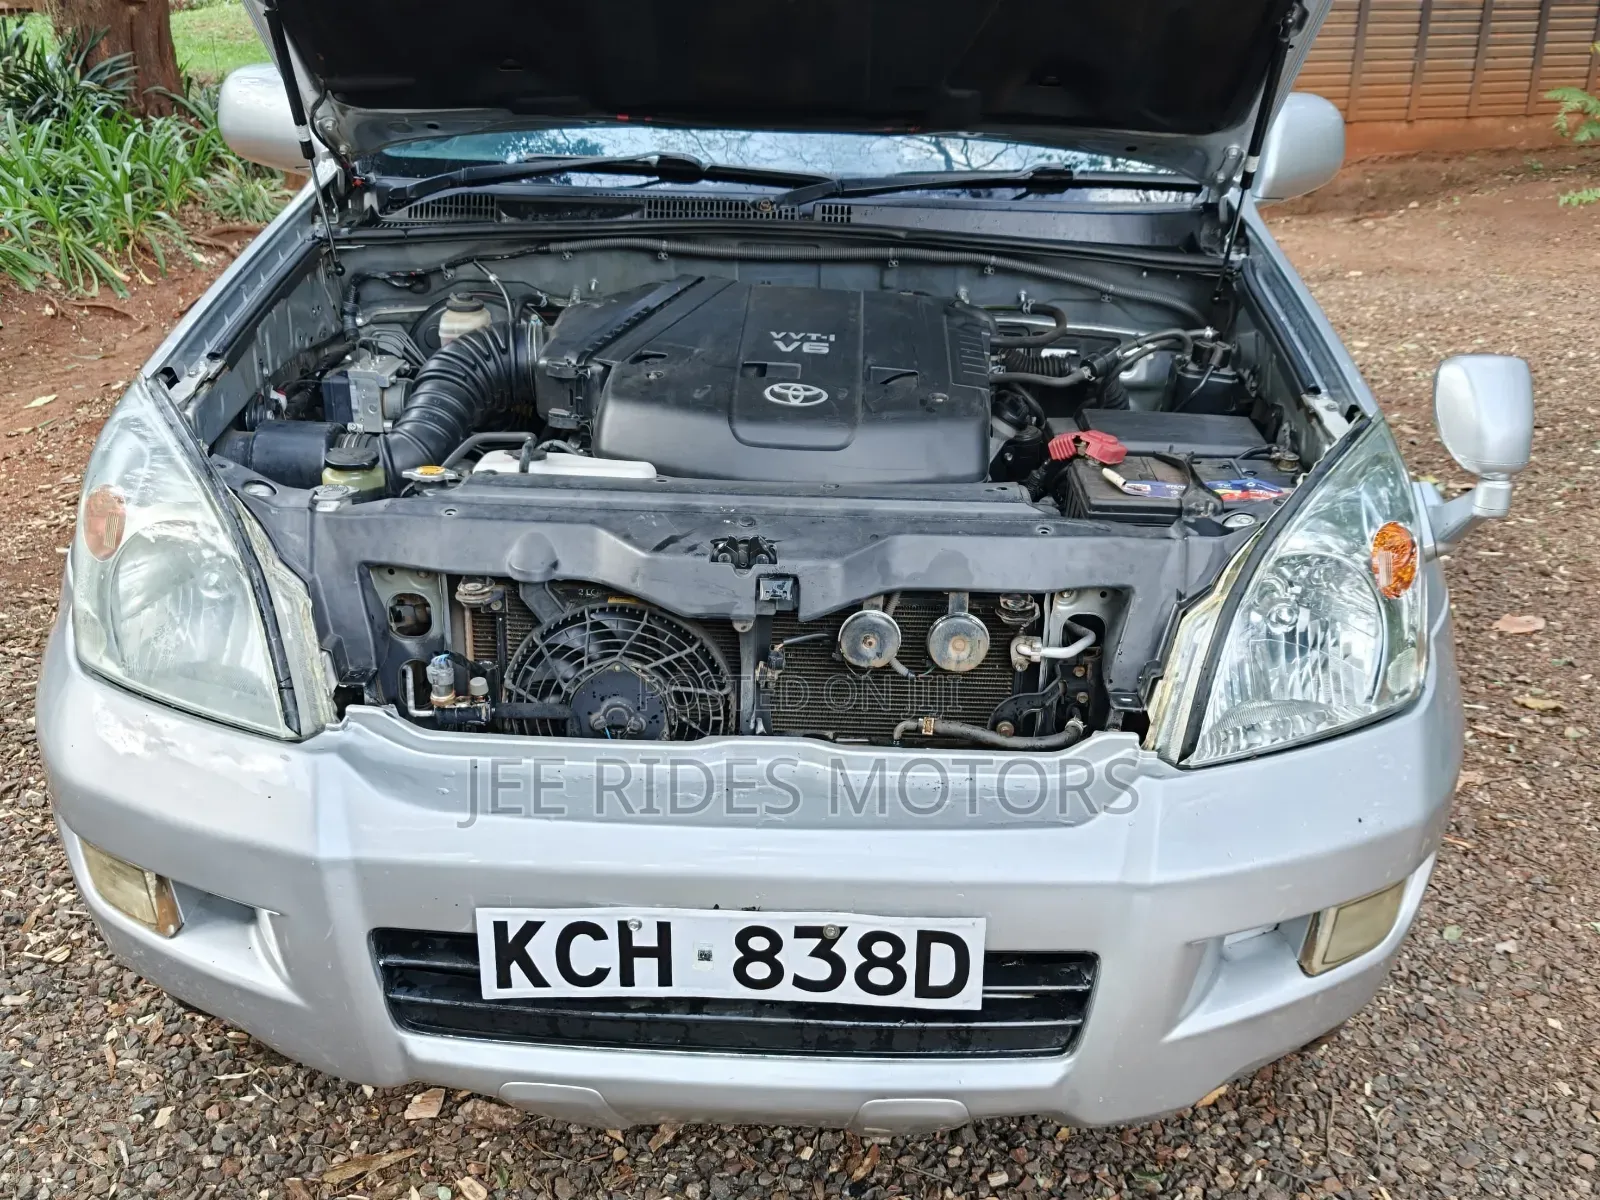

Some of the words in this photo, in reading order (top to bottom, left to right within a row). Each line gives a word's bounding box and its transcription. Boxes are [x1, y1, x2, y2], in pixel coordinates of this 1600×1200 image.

[773, 340, 830, 354] V6
[492, 919, 674, 990] KCH
[732, 924, 971, 999] 838D
